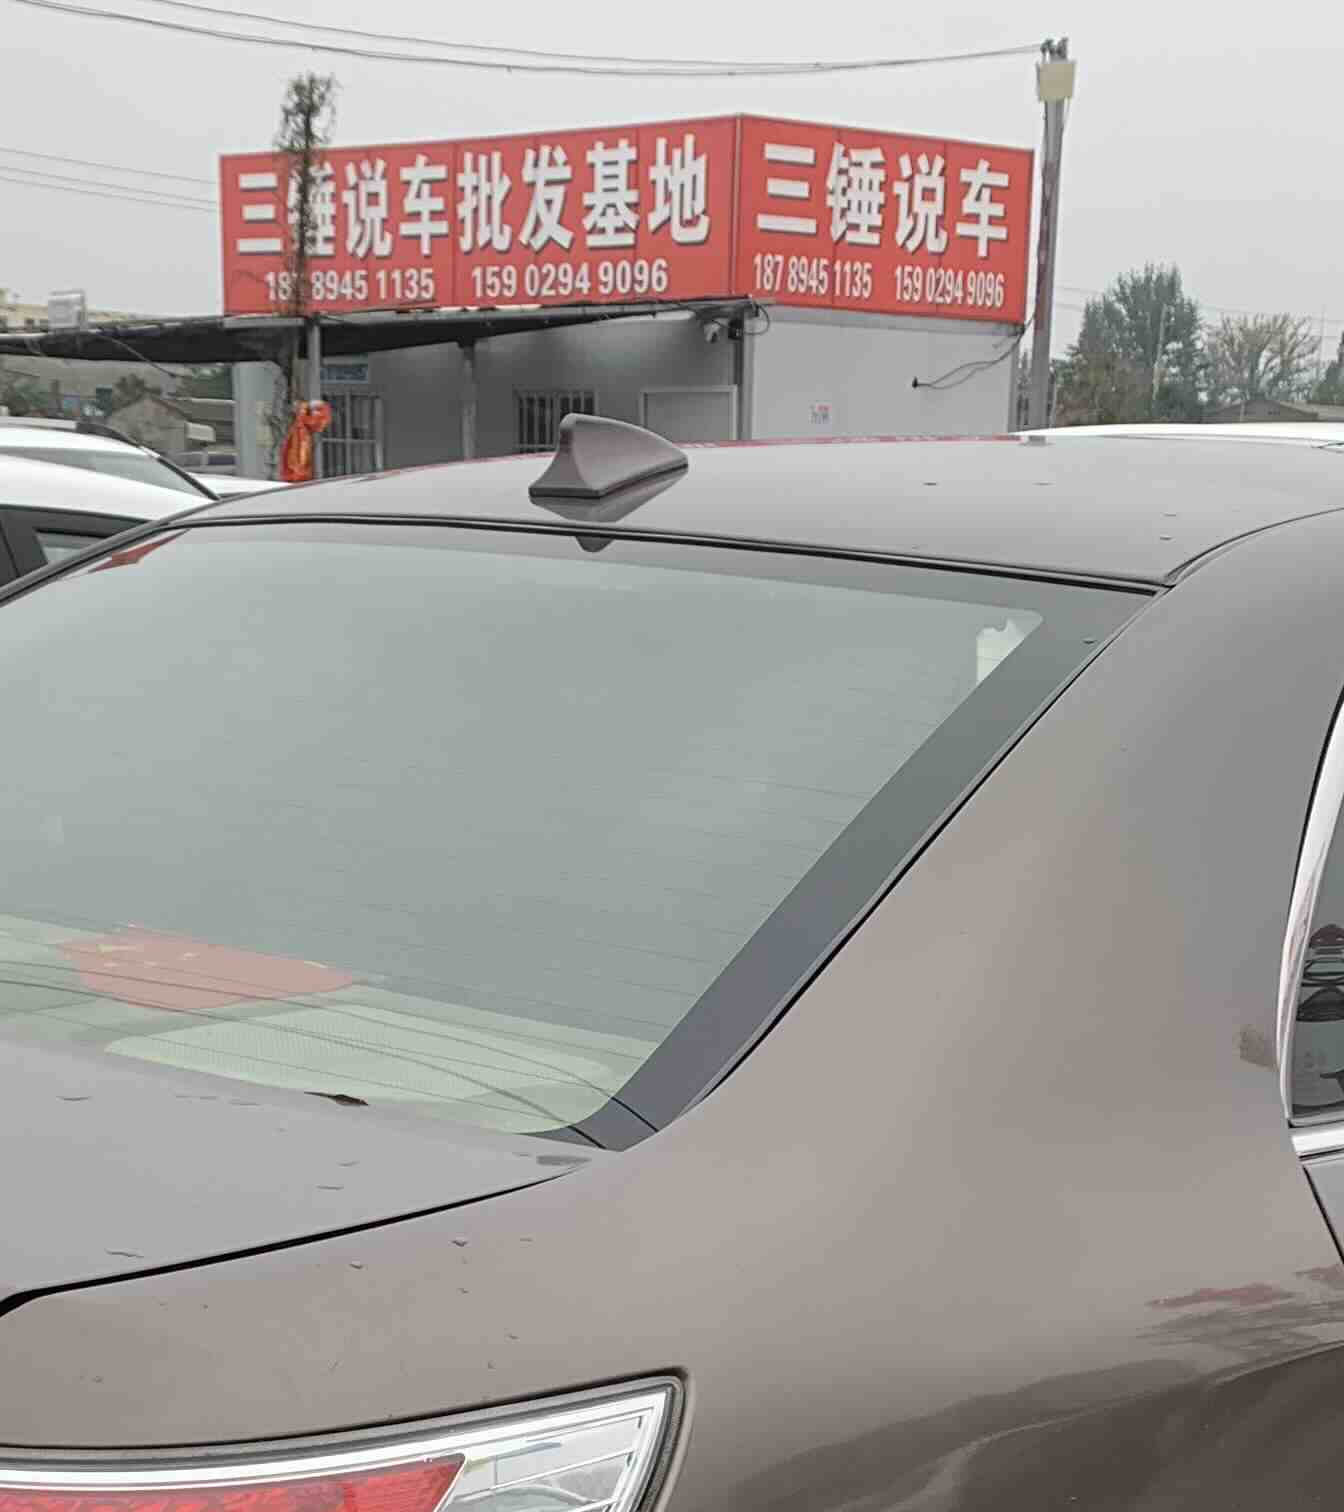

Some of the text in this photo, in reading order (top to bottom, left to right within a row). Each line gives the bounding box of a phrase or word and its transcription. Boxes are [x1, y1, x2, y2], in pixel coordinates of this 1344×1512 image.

[236, 133, 710, 259] 三锤说车批发基地
[756, 142, 1010, 258] 三锤说车
[265, 258, 669, 301] 18 8945 1135 159 0294 9096
[754, 252, 1005, 309] 187 8945 1135 159 0294 9096
